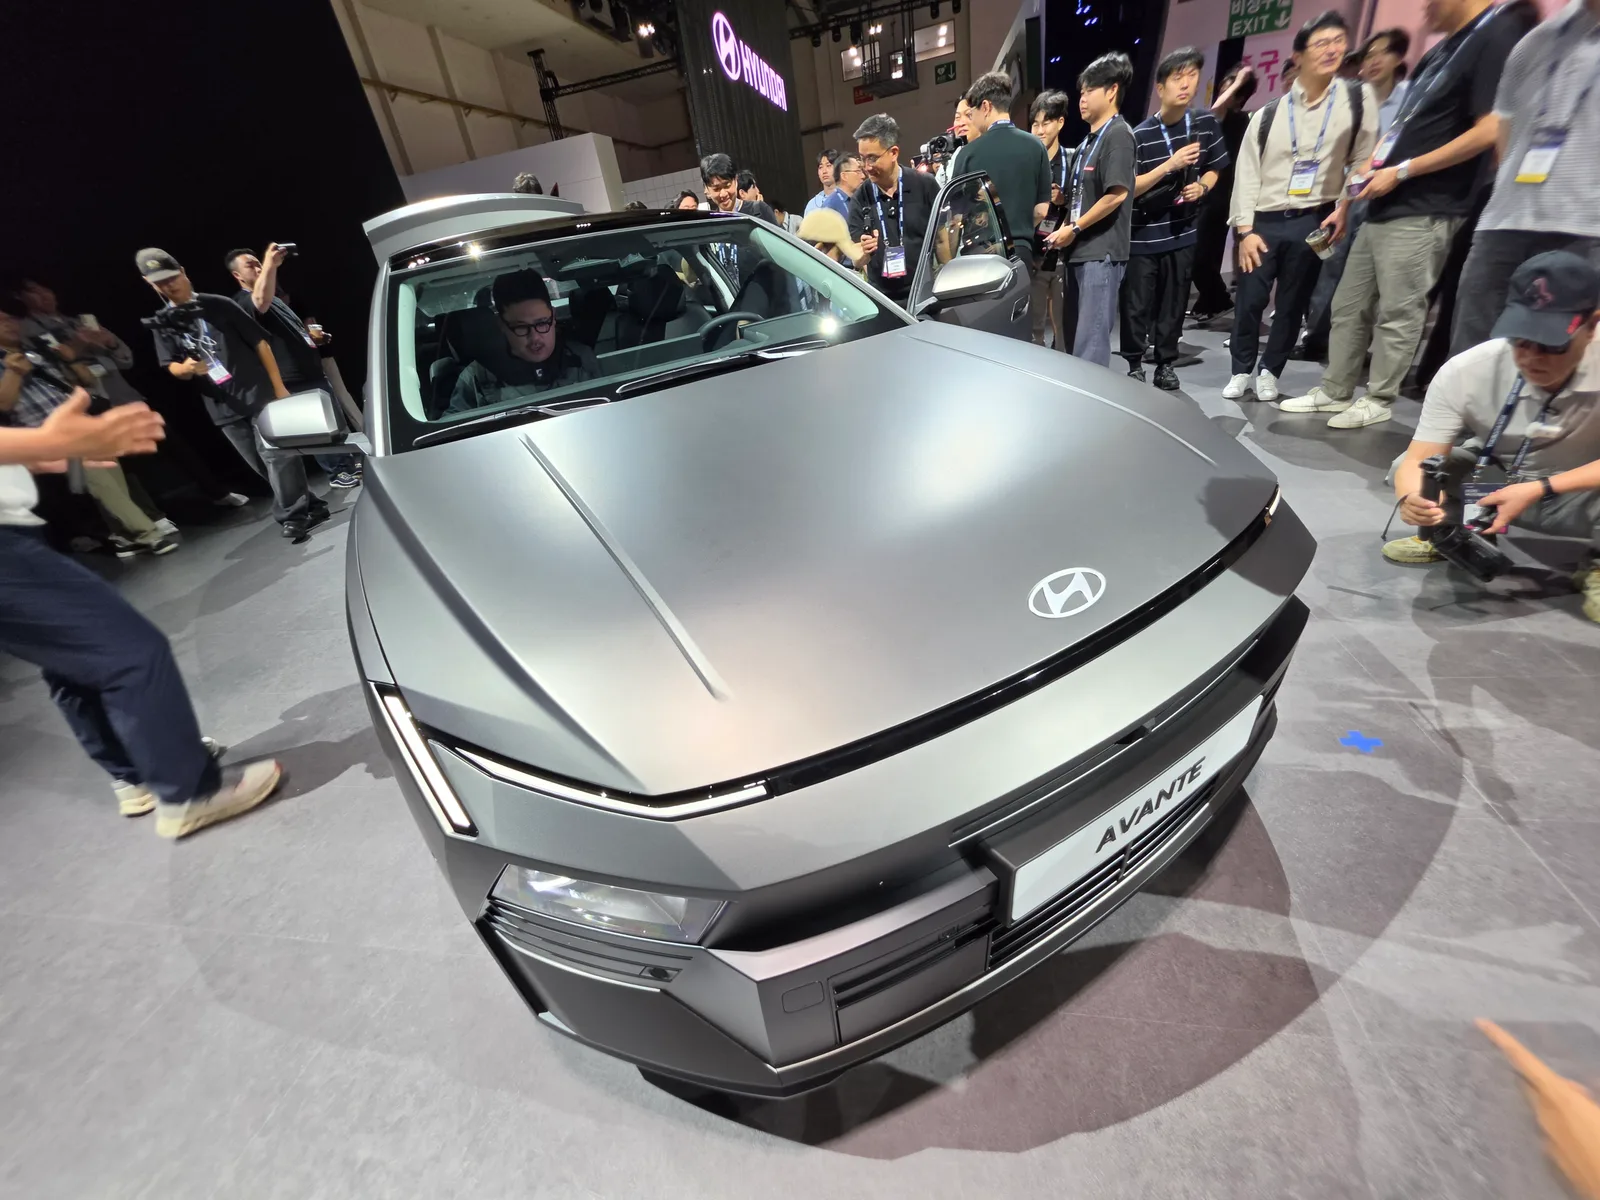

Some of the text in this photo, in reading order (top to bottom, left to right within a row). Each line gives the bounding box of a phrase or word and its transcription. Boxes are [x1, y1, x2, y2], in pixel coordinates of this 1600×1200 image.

[1231, 14, 1271, 37] EXIT
[739, 39, 788, 112] HYUNDAI
[1095, 756, 1206, 853] AVANTE
